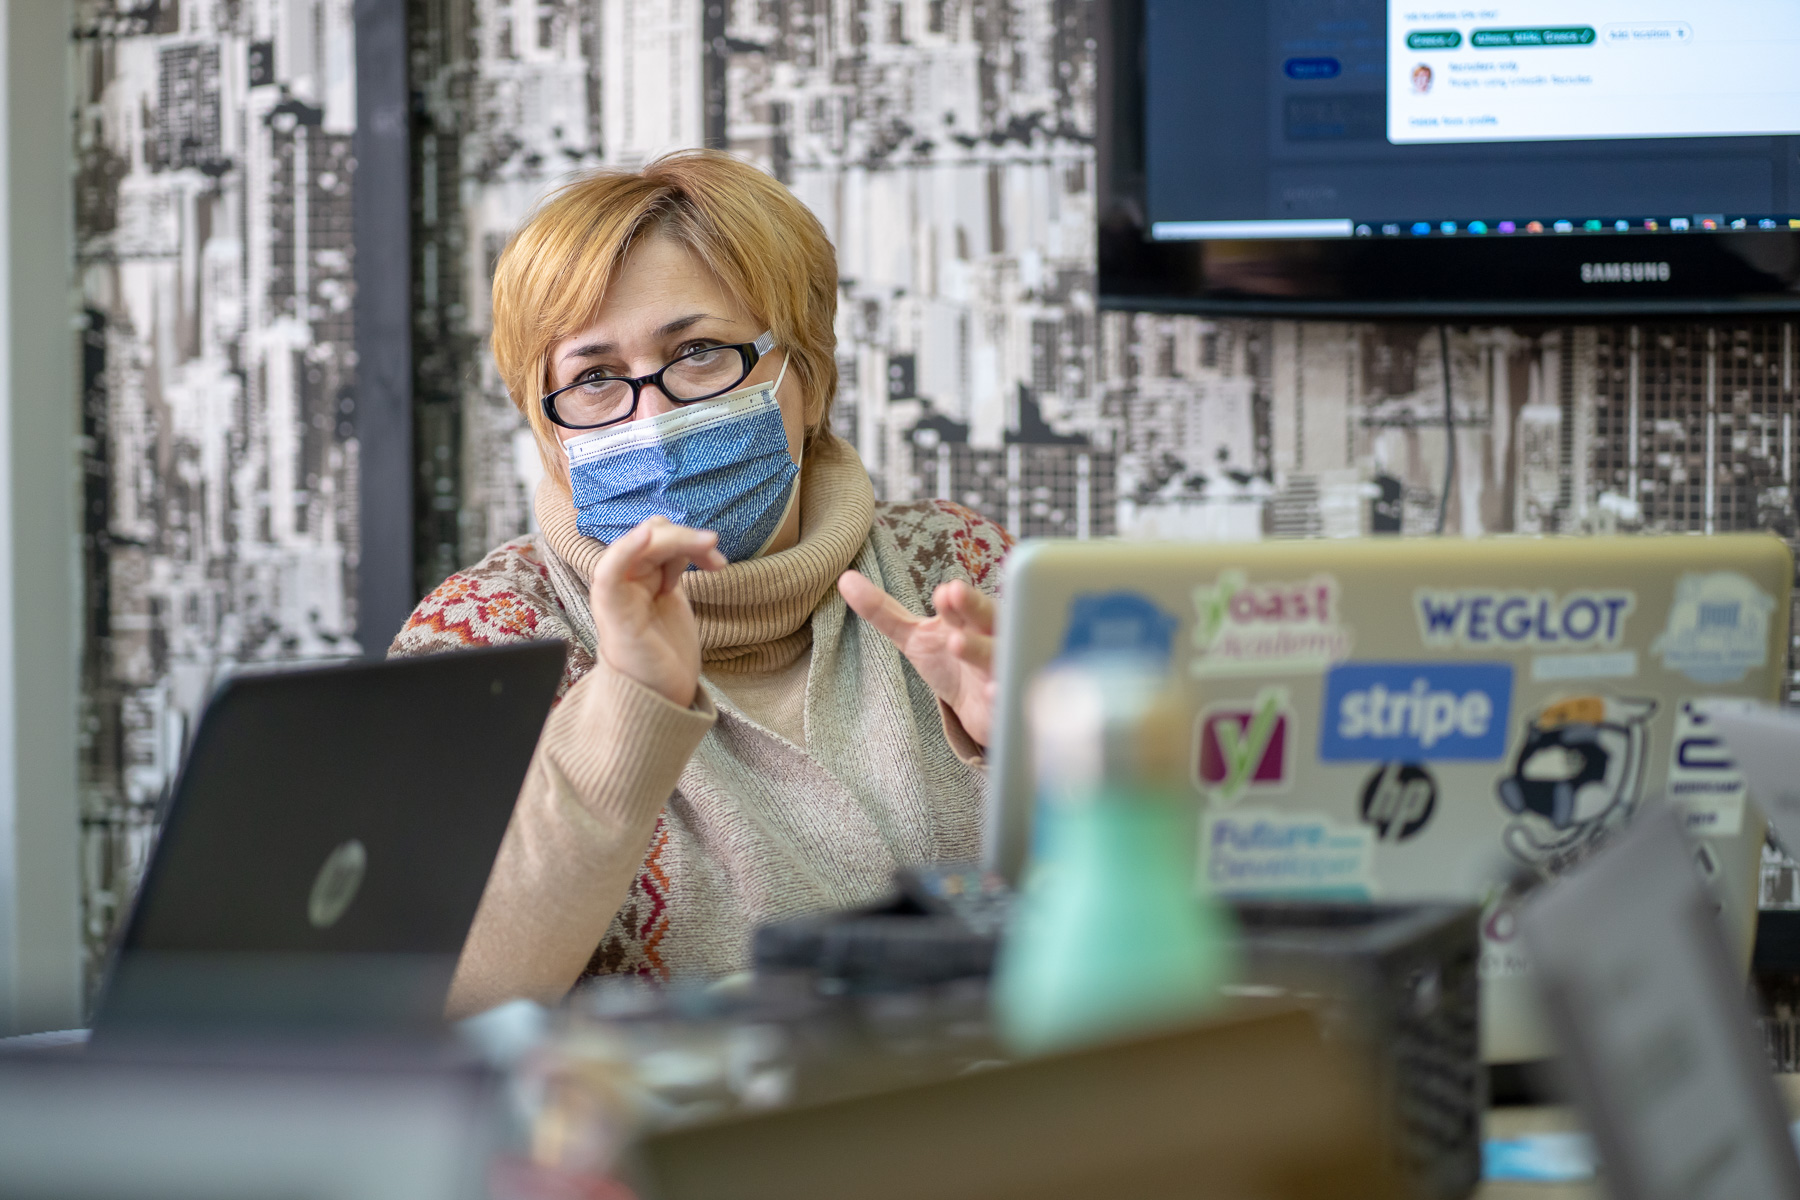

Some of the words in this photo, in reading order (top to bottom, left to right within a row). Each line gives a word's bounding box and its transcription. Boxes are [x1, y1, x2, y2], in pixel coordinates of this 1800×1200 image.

[1581, 262, 1670, 283] SAMSUNG
[1422, 597, 1628, 643] WEGLOT
[1339, 678, 1493, 748] stripe
[1212, 819, 1326, 850] Future
